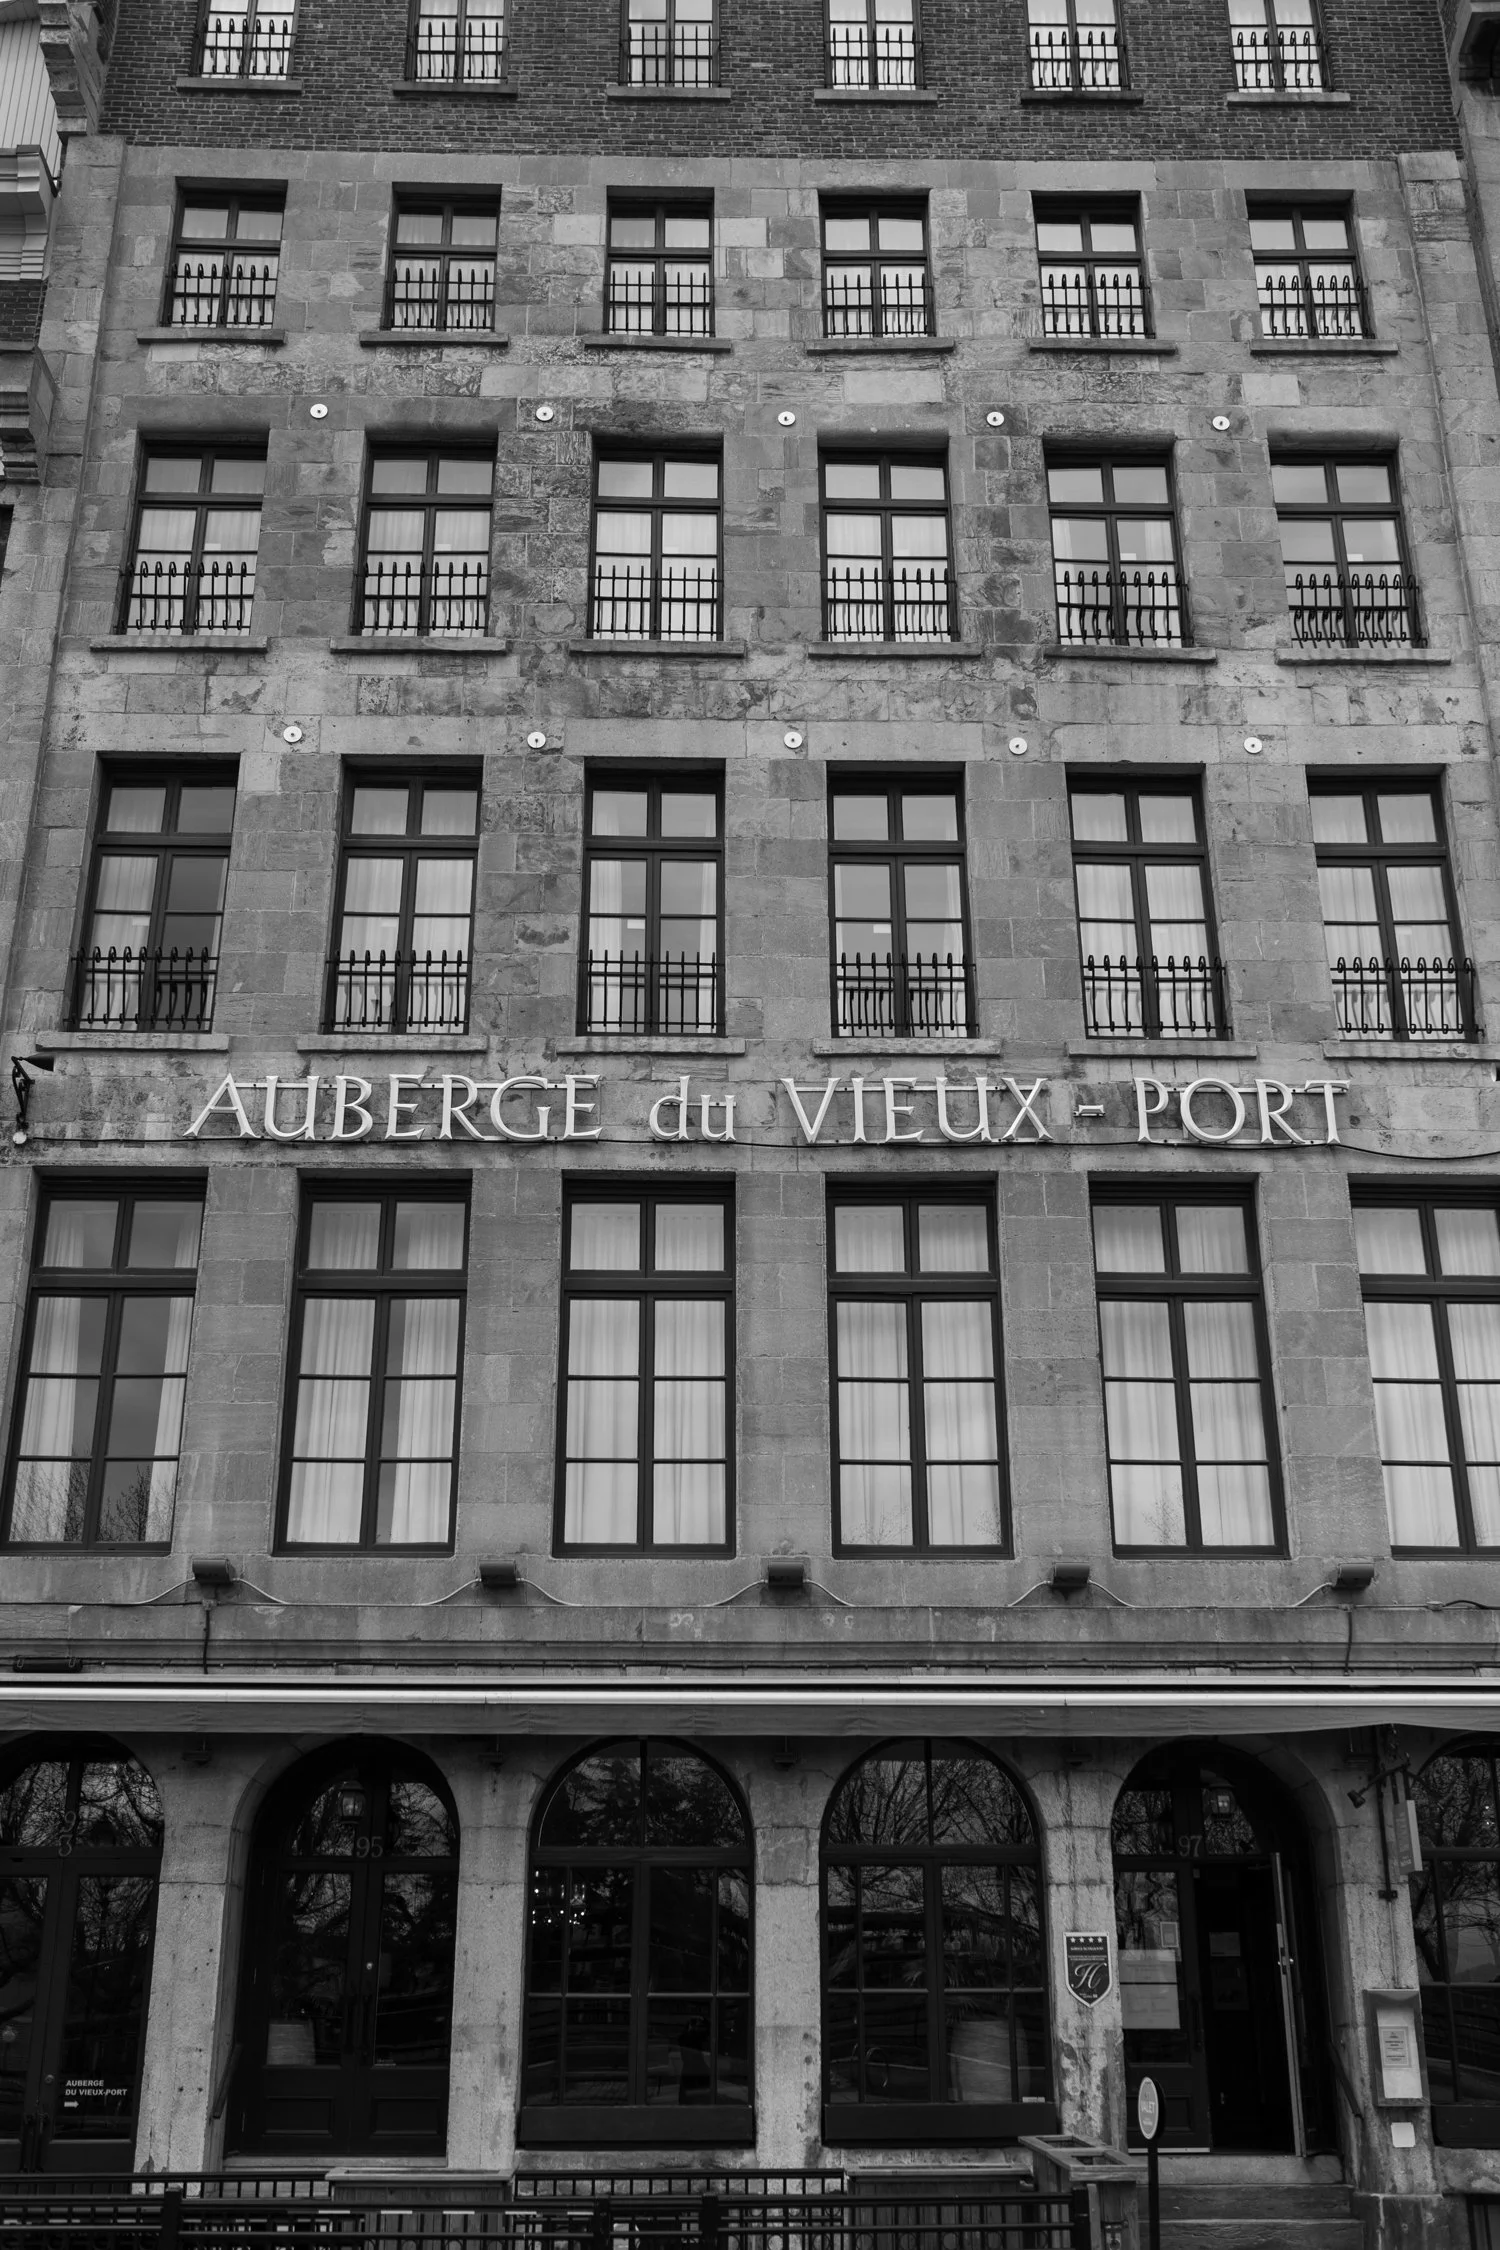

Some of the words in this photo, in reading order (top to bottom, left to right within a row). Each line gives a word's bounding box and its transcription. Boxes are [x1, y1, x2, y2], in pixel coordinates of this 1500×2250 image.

[182, 1073, 603, 1142] AUBERGE
[648, 1075, 736, 1142] du
[780, 1076, 1054, 1144] VIEUX
[1133, 1076, 1352, 1145] PORT
[356, 1836, 384, 1858] 95
[1178, 1835, 1203, 1858] 97
[65, 2088, 77, 2096] DU
[78, 2088, 128, 2096] VIEUX-PORT
